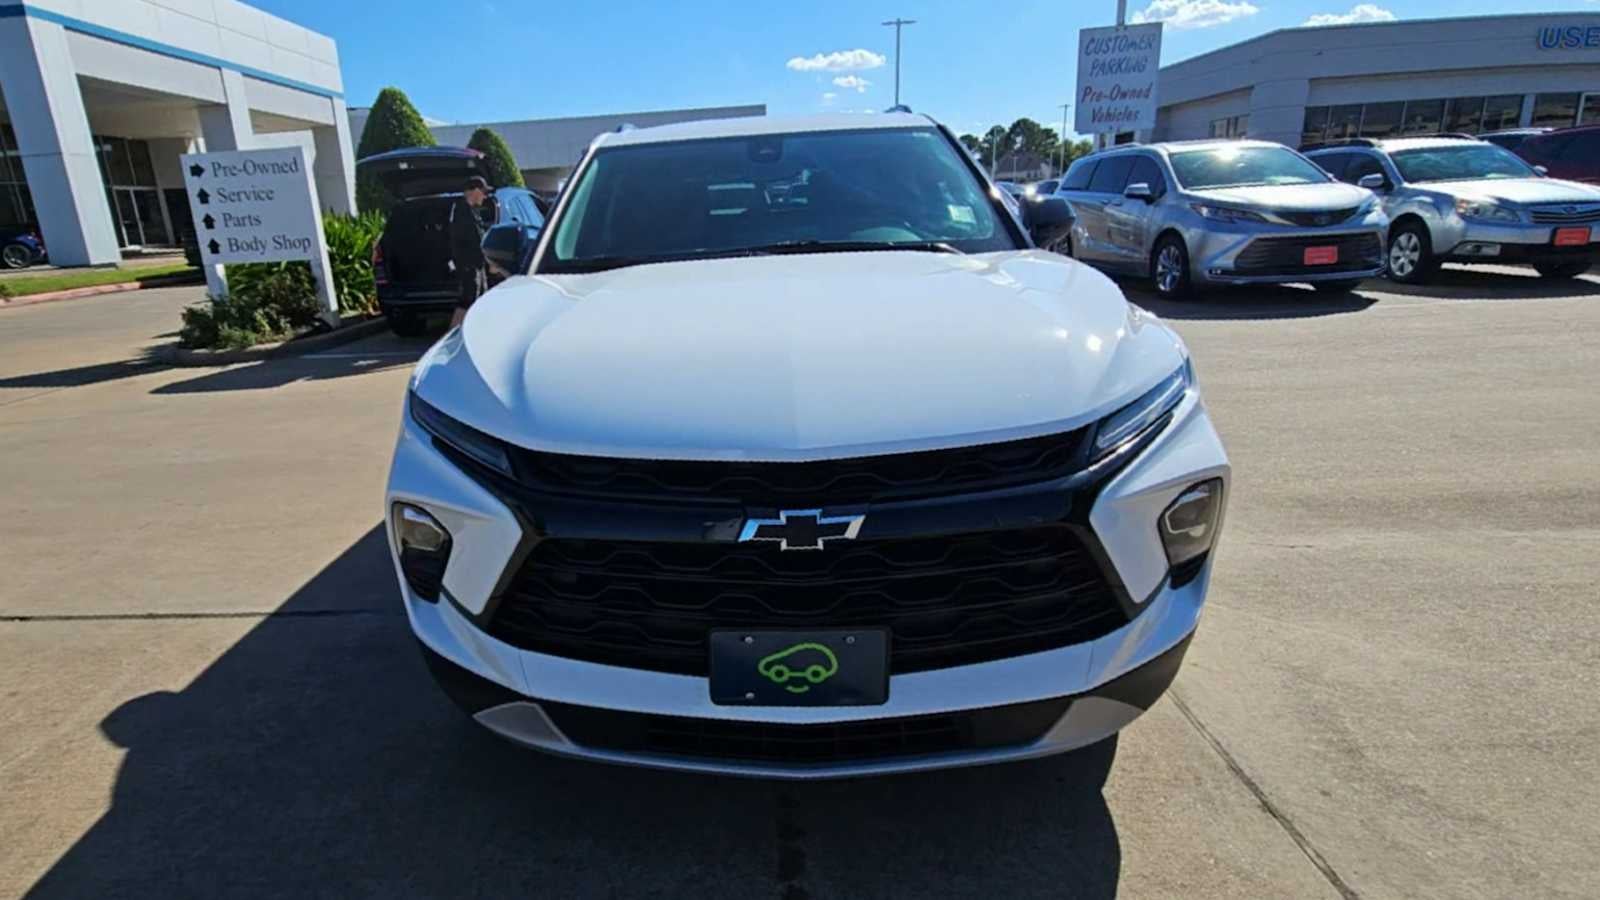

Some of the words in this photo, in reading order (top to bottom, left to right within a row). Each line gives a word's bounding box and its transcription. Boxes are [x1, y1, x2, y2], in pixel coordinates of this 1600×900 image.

[1085, 34, 1156, 56] CUSTOMER
[1539, 26, 1600, 48] USE
[1090, 56, 1148, 78] PARKING
[1081, 82, 1153, 104] Pre-Owned
[1091, 105, 1140, 123] Vehicles
[211, 157, 299, 177] Pre-Owned
[216, 186, 275, 203] Service
[222, 213, 262, 228] Parts
[227, 236, 267, 255] Body
[272, 235, 311, 252] Shop
